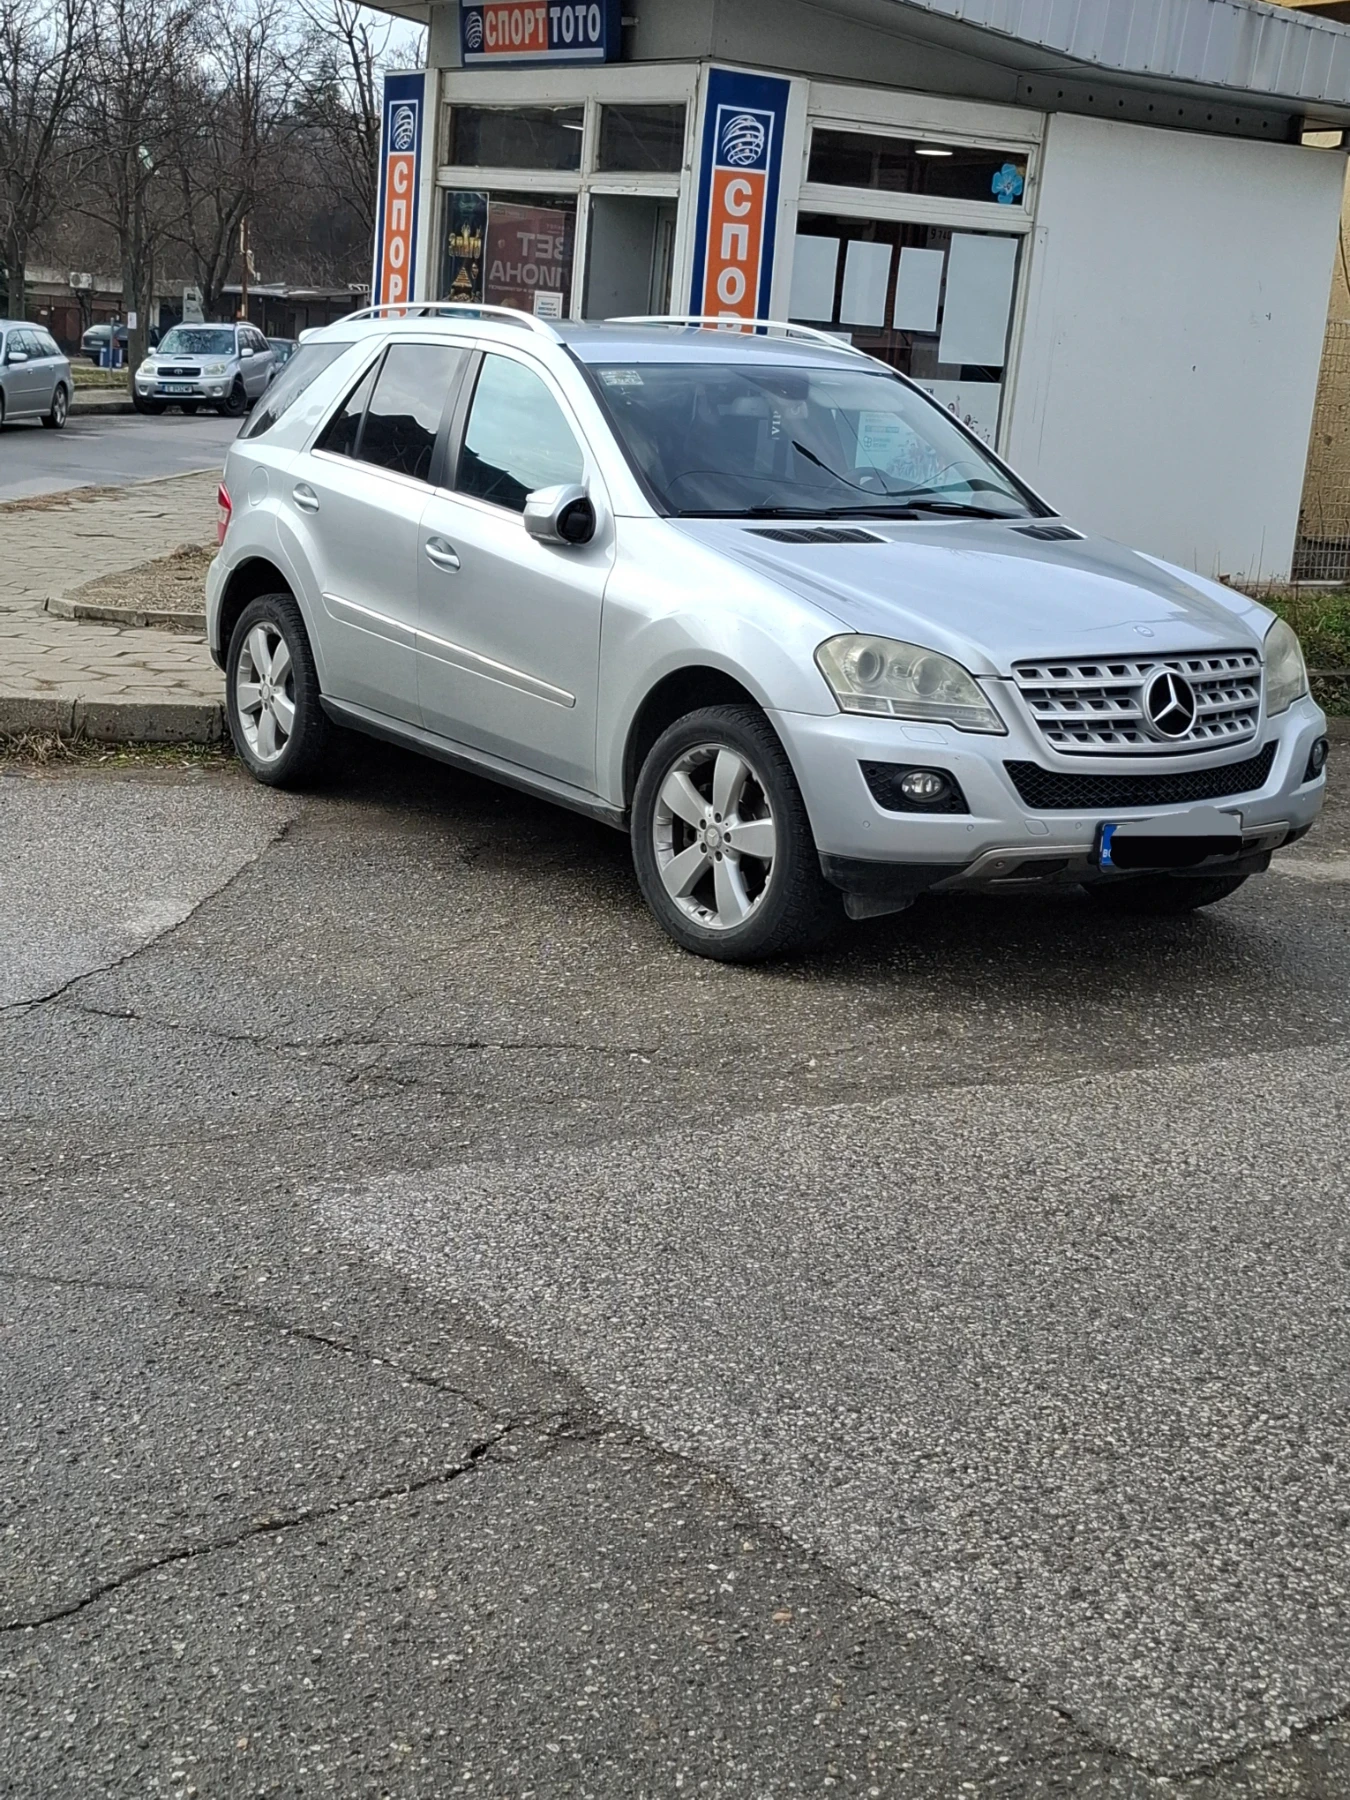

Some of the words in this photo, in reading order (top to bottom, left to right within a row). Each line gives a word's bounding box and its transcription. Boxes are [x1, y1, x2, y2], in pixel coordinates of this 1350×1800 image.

[485, 8, 546, 47] СПОРТ
[550, 3, 600, 43] ТОТО
[387, 161, 409, 318] СПОР
